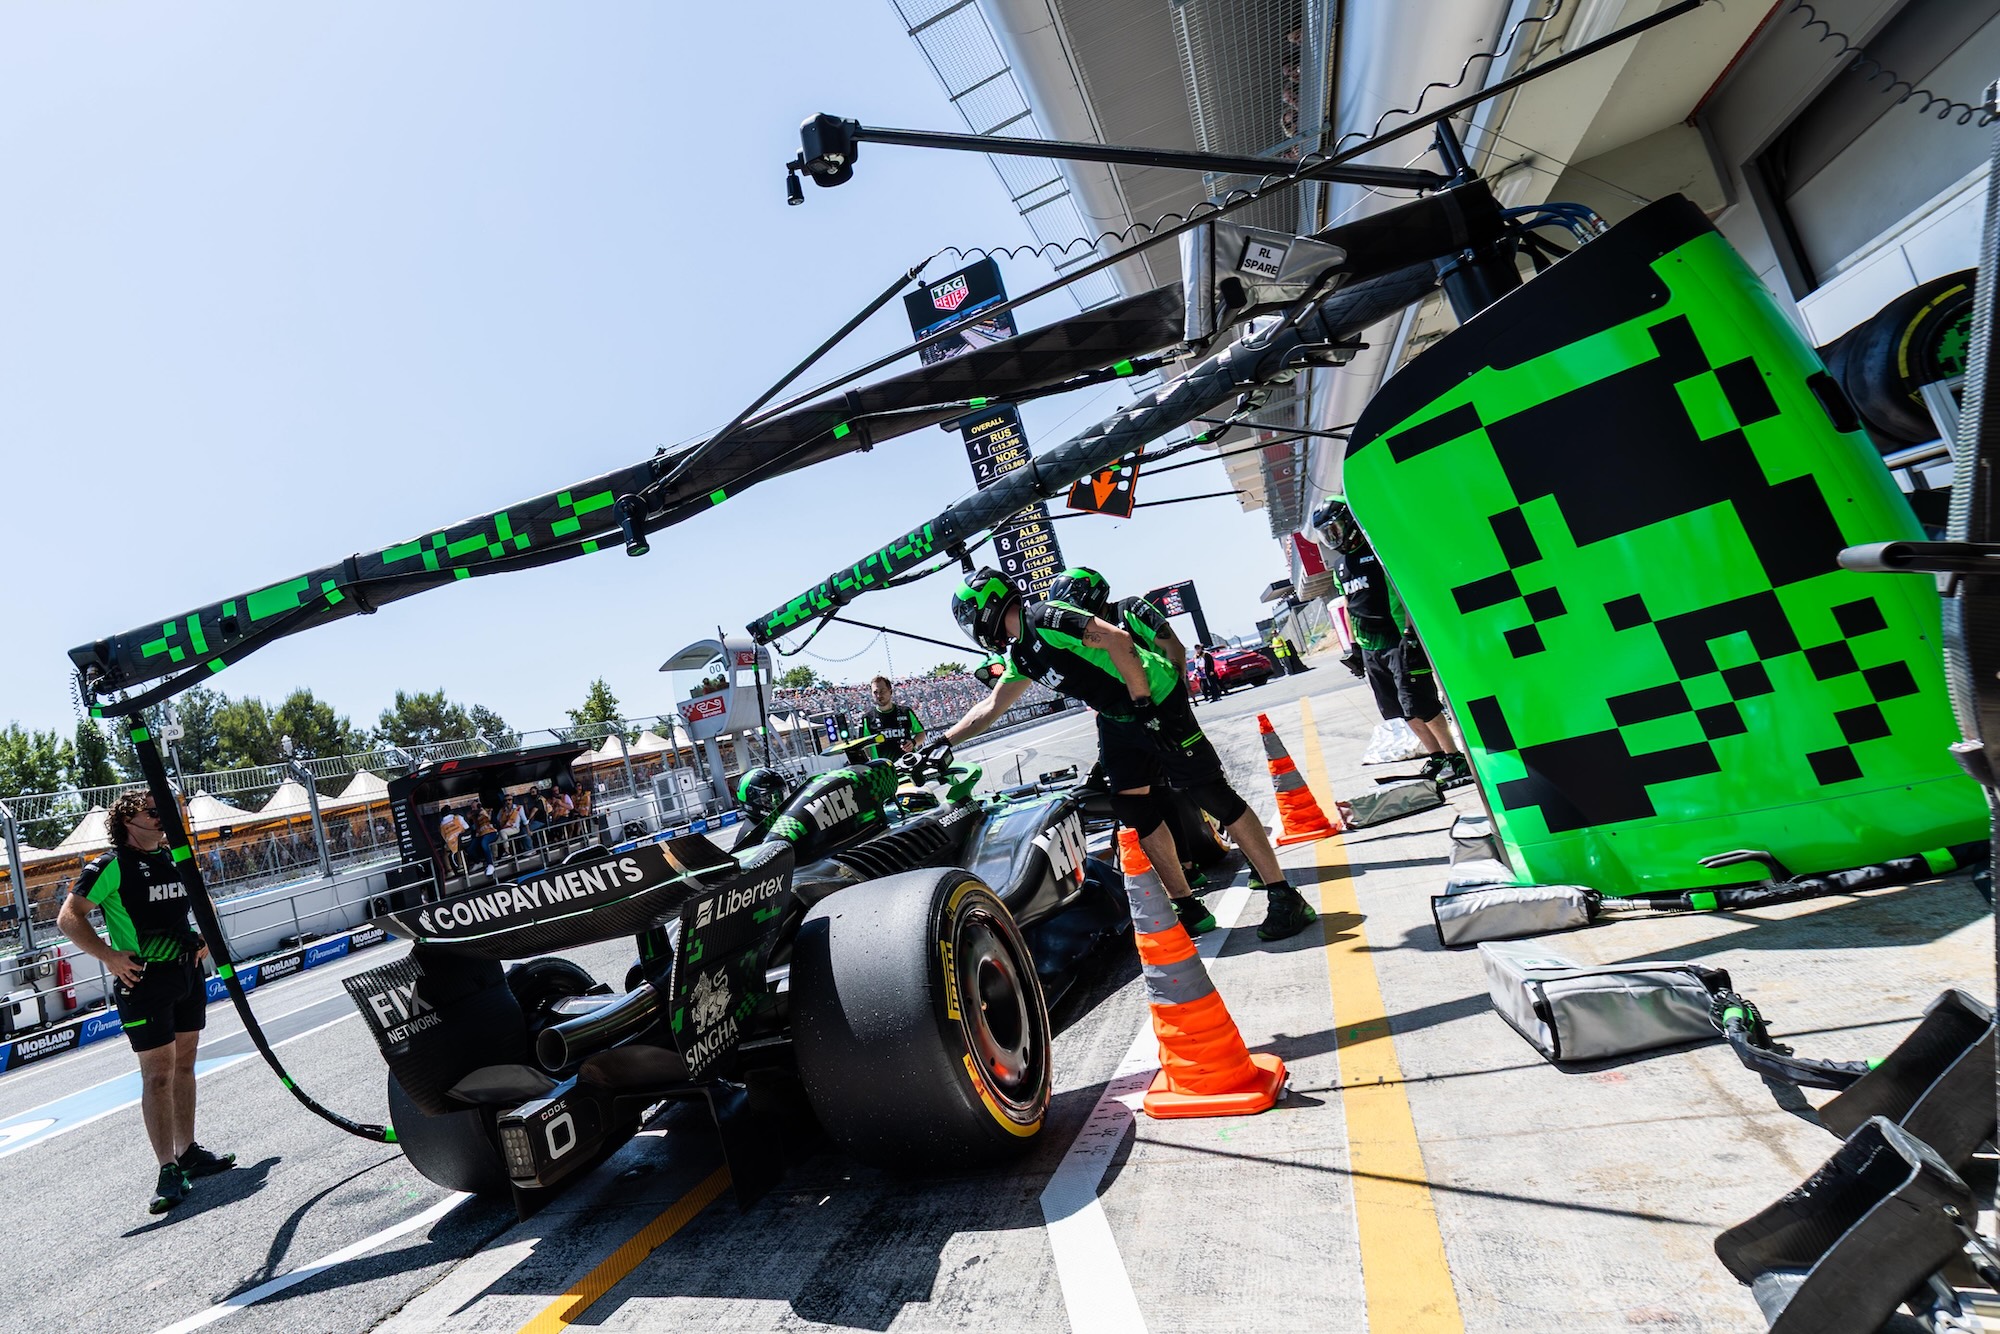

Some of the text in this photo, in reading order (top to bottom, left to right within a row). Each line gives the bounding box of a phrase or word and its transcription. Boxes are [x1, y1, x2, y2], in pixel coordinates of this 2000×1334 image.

[1258, 247, 1271, 259] RL
[1244, 258, 1278, 275] SPARE
[933, 278, 964, 297] TAG
[934, 288, 968, 309] HEUER
[971, 417, 1004, 434] OVERALL
[989, 428, 1012, 443] RUS
[973, 443, 982, 455] 1
[995, 449, 1018, 463] NOR
[979, 464, 989, 477] 2
[1019, 524, 1040, 538] ALB
[1001, 537, 1011, 551] 8
[1024, 545, 1047, 559] HAD
[1007, 559, 1017, 571] 9
[1031, 567, 1053, 580] STR
[1017, 578, 1055, 591] 0 1:14.4
[168, 728, 179, 737] 20
[803, 784, 859, 831] KICK
[1031, 810, 1087, 881] KICK
[434, 857, 644, 930] COINPAYMENTS
[716, 874, 785, 920] Libertex
[261, 956, 300, 976] MOBLAND
[367, 980, 434, 1029] FIX
[386, 1012, 442, 1044] NETWORK
[17, 1029, 75, 1056] MOBLAND
[24, 1040, 71, 1060] NOW STREAMING
[685, 1015, 738, 1072] SINGHA
[541, 1100, 567, 1121] CODE
[545, 1112, 577, 1160] 0
